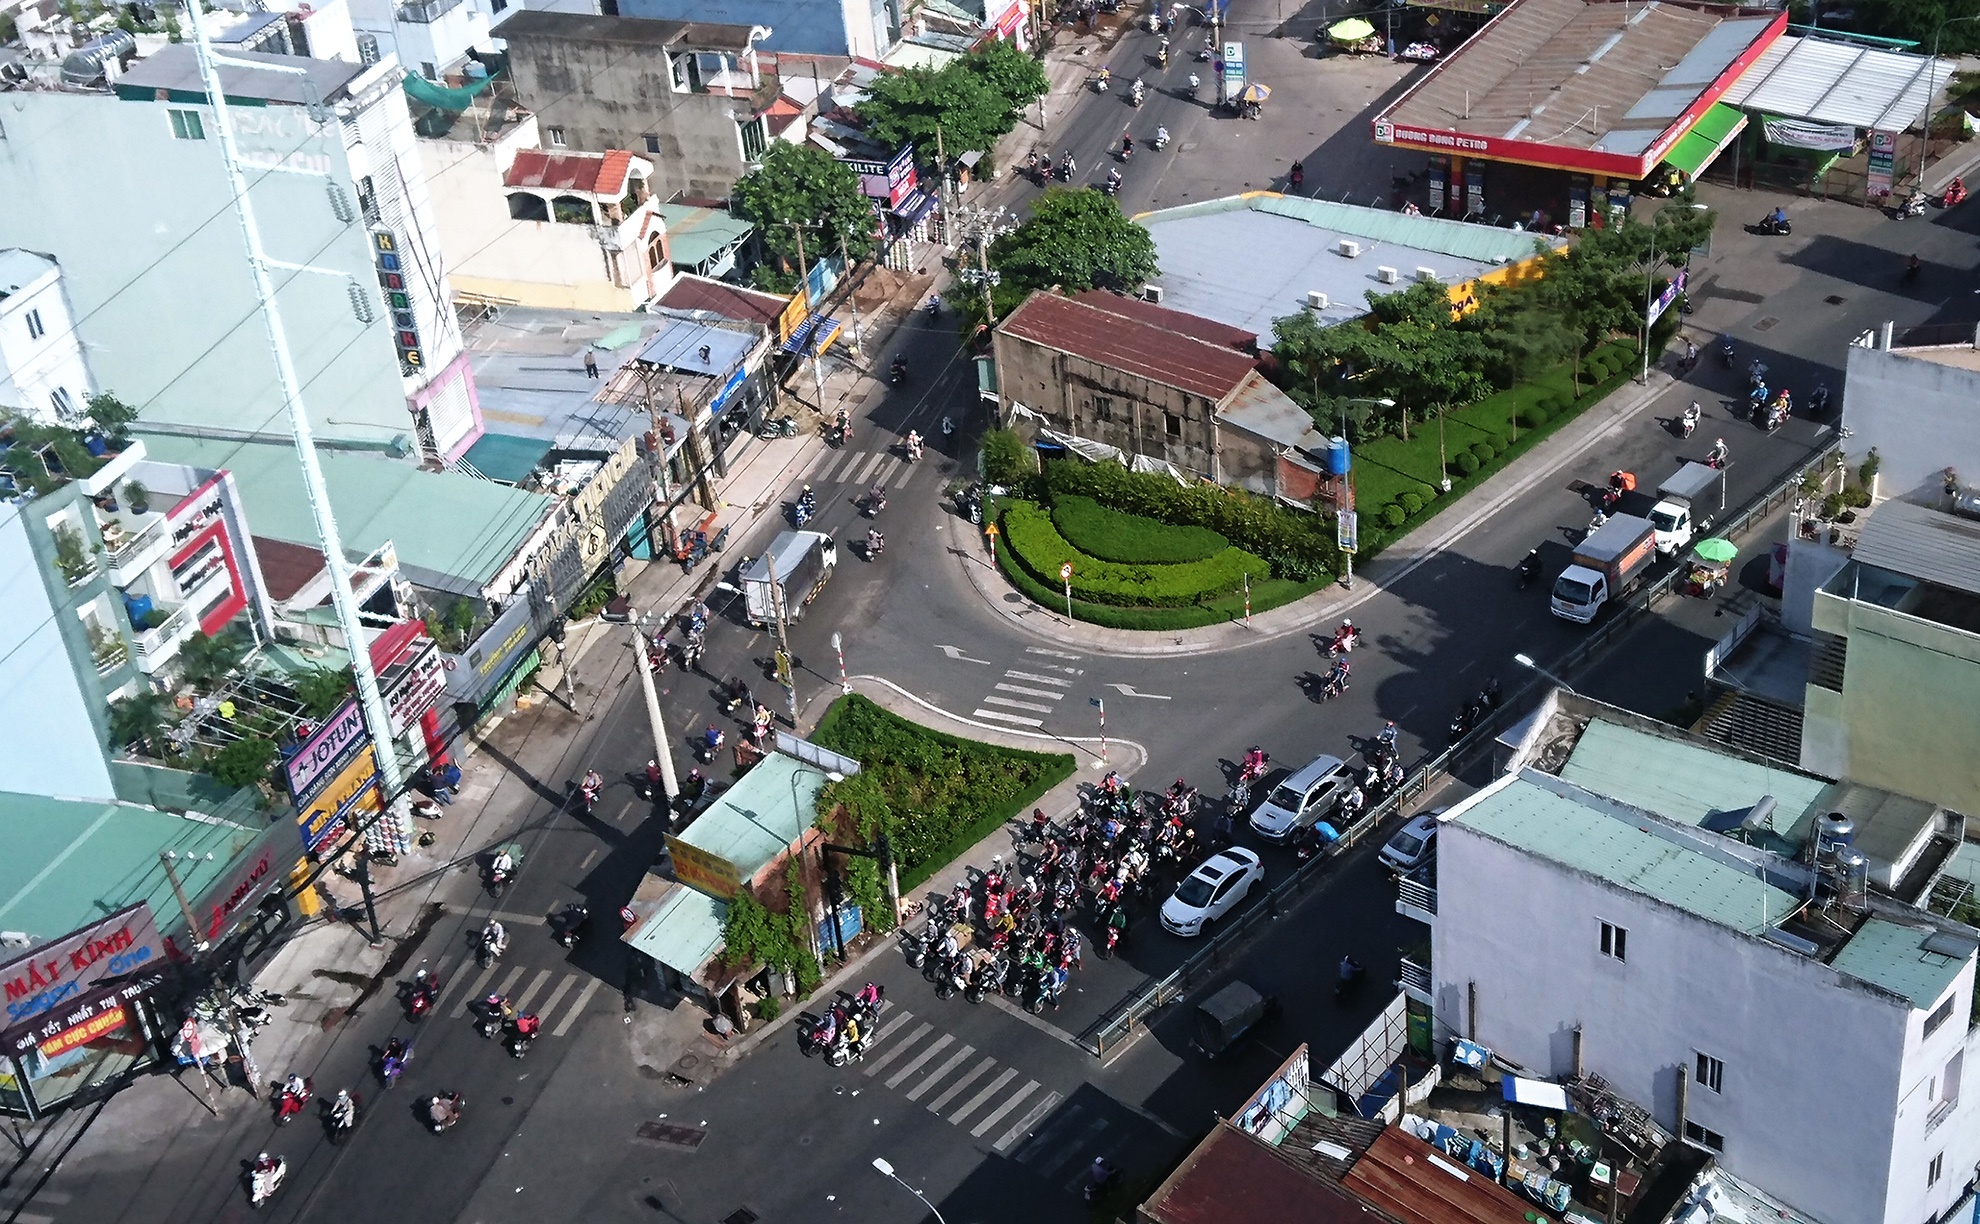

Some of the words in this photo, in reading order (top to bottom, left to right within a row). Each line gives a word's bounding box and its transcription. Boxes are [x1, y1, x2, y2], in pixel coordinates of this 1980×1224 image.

[1456, 138, 1488, 151] PETRO
[377, 232, 420, 365] KARAOKE
[311, 709, 360, 772] JOTUN
[3, 958, 60, 1002] MẮT
[16, 1031, 37, 1050] GIÁ
[41, 1019, 62, 1038] TỐT
[67, 1003, 94, 1026] NHẤT
